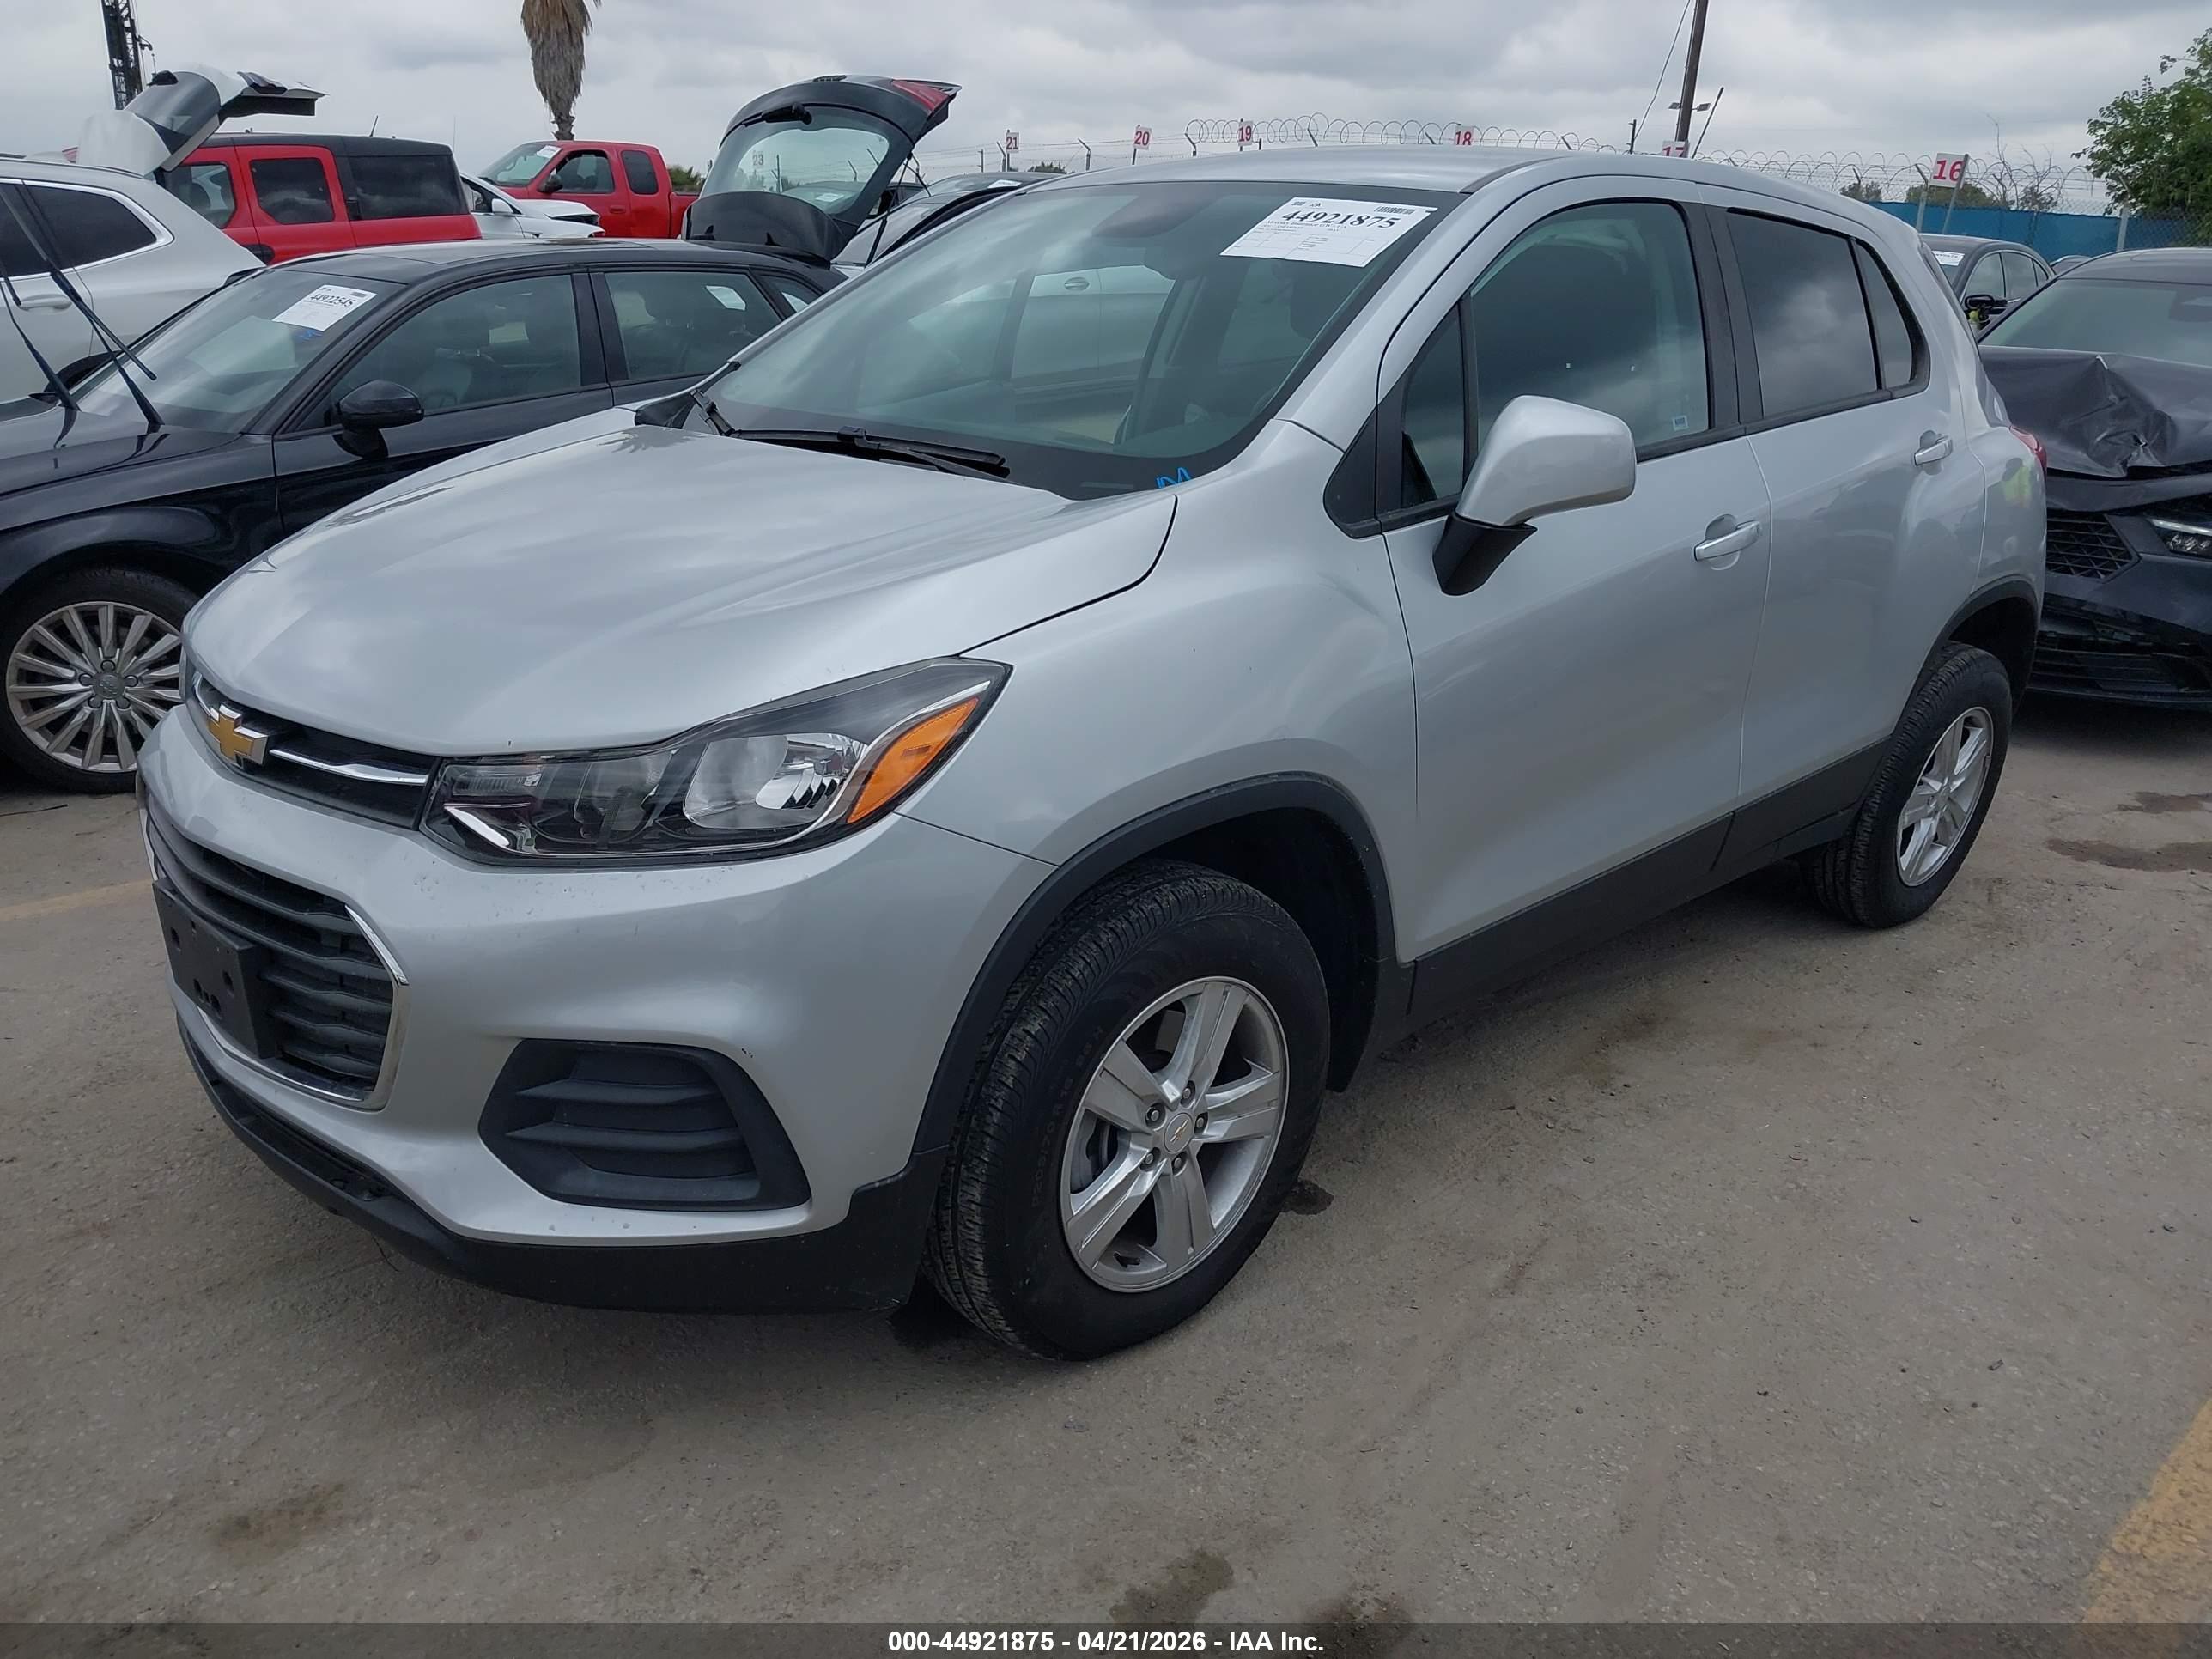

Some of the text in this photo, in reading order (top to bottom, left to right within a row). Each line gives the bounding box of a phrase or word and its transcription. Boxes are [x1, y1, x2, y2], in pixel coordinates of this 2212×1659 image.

[1133, 131, 1150, 146] 20
[1238, 125, 1252, 143] 19
[1455, 131, 1473, 146] 18
[1006, 136, 1018, 150] 21
[1932, 159, 1965, 182] 16
[1281, 210, 1402, 229] 44921875
